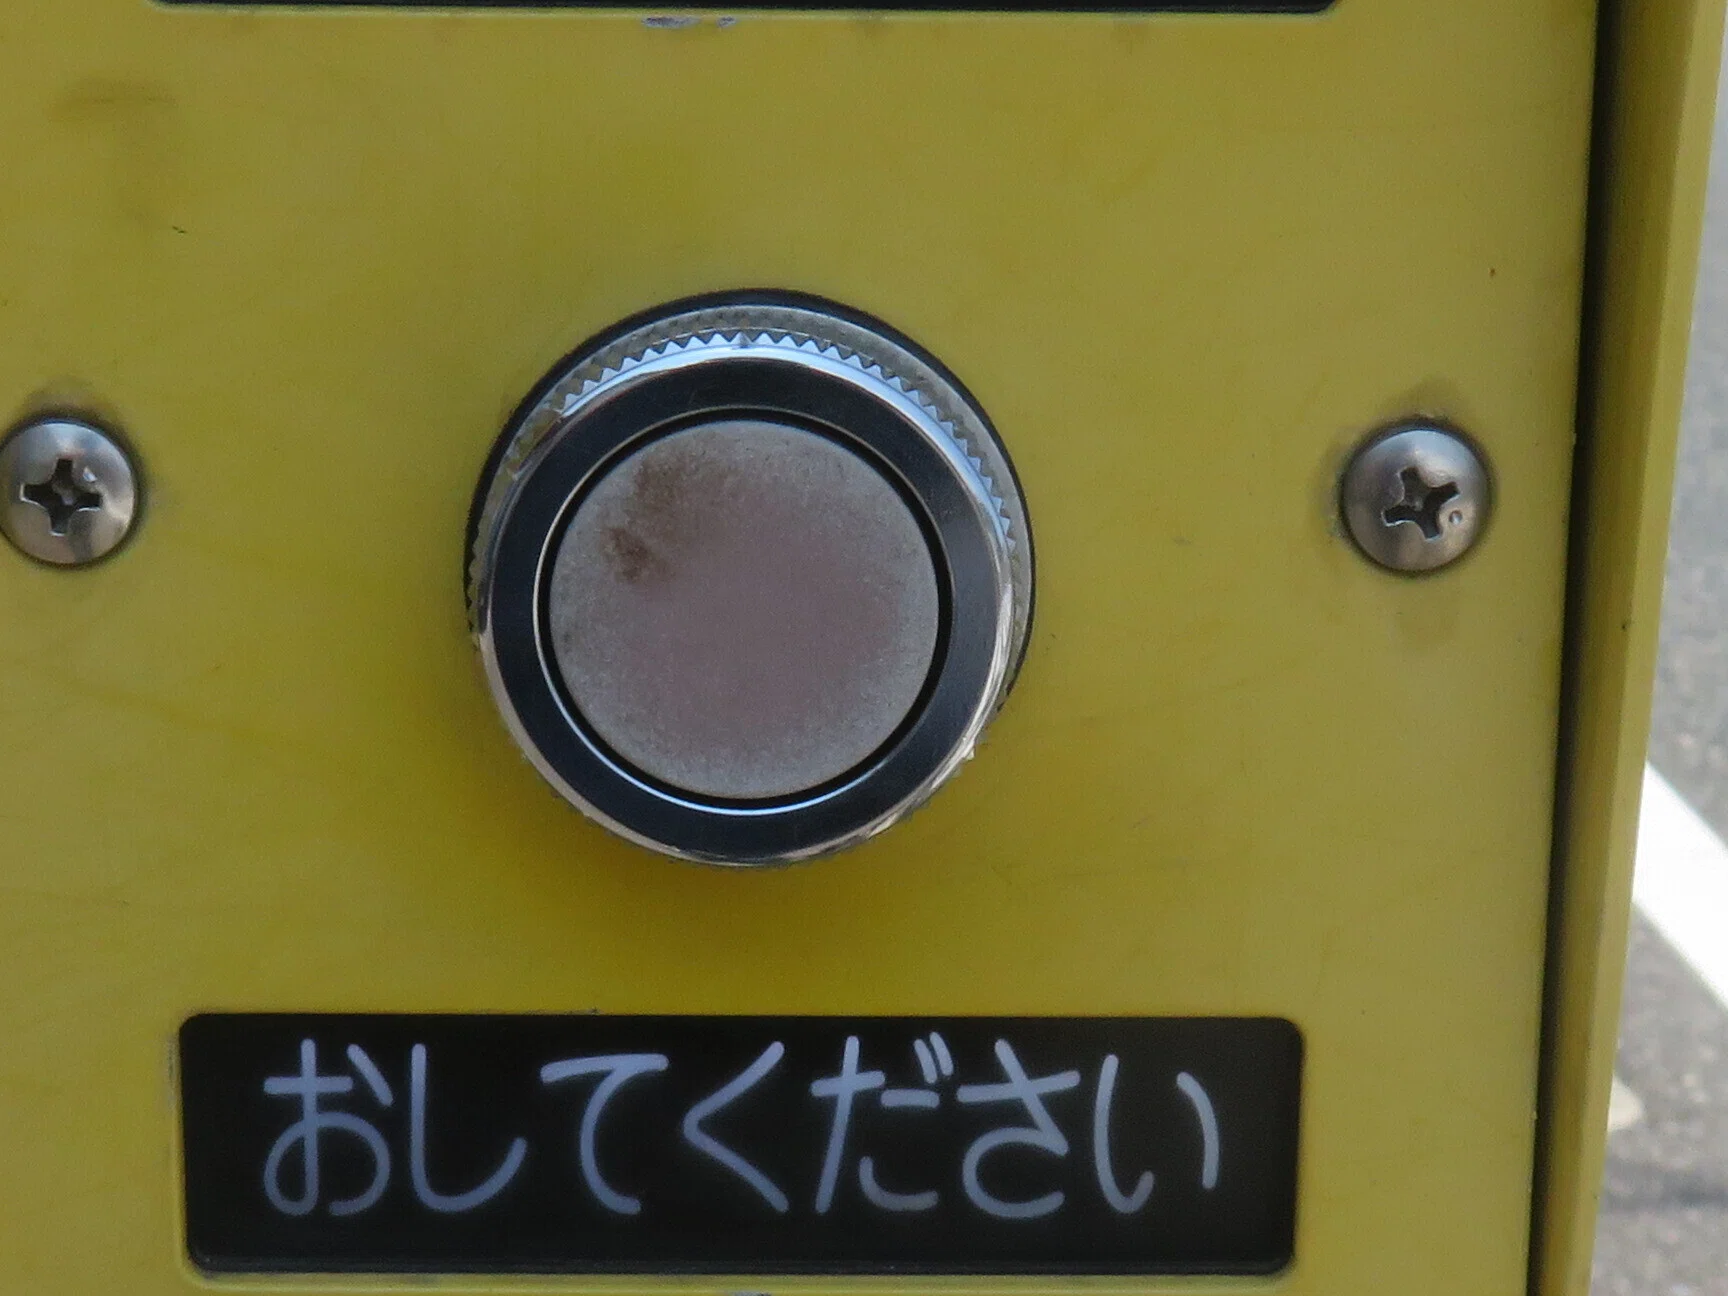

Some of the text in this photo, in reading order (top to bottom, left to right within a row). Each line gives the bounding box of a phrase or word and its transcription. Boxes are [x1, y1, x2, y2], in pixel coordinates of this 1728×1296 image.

[263, 1032, 1221, 1218] おしてください
